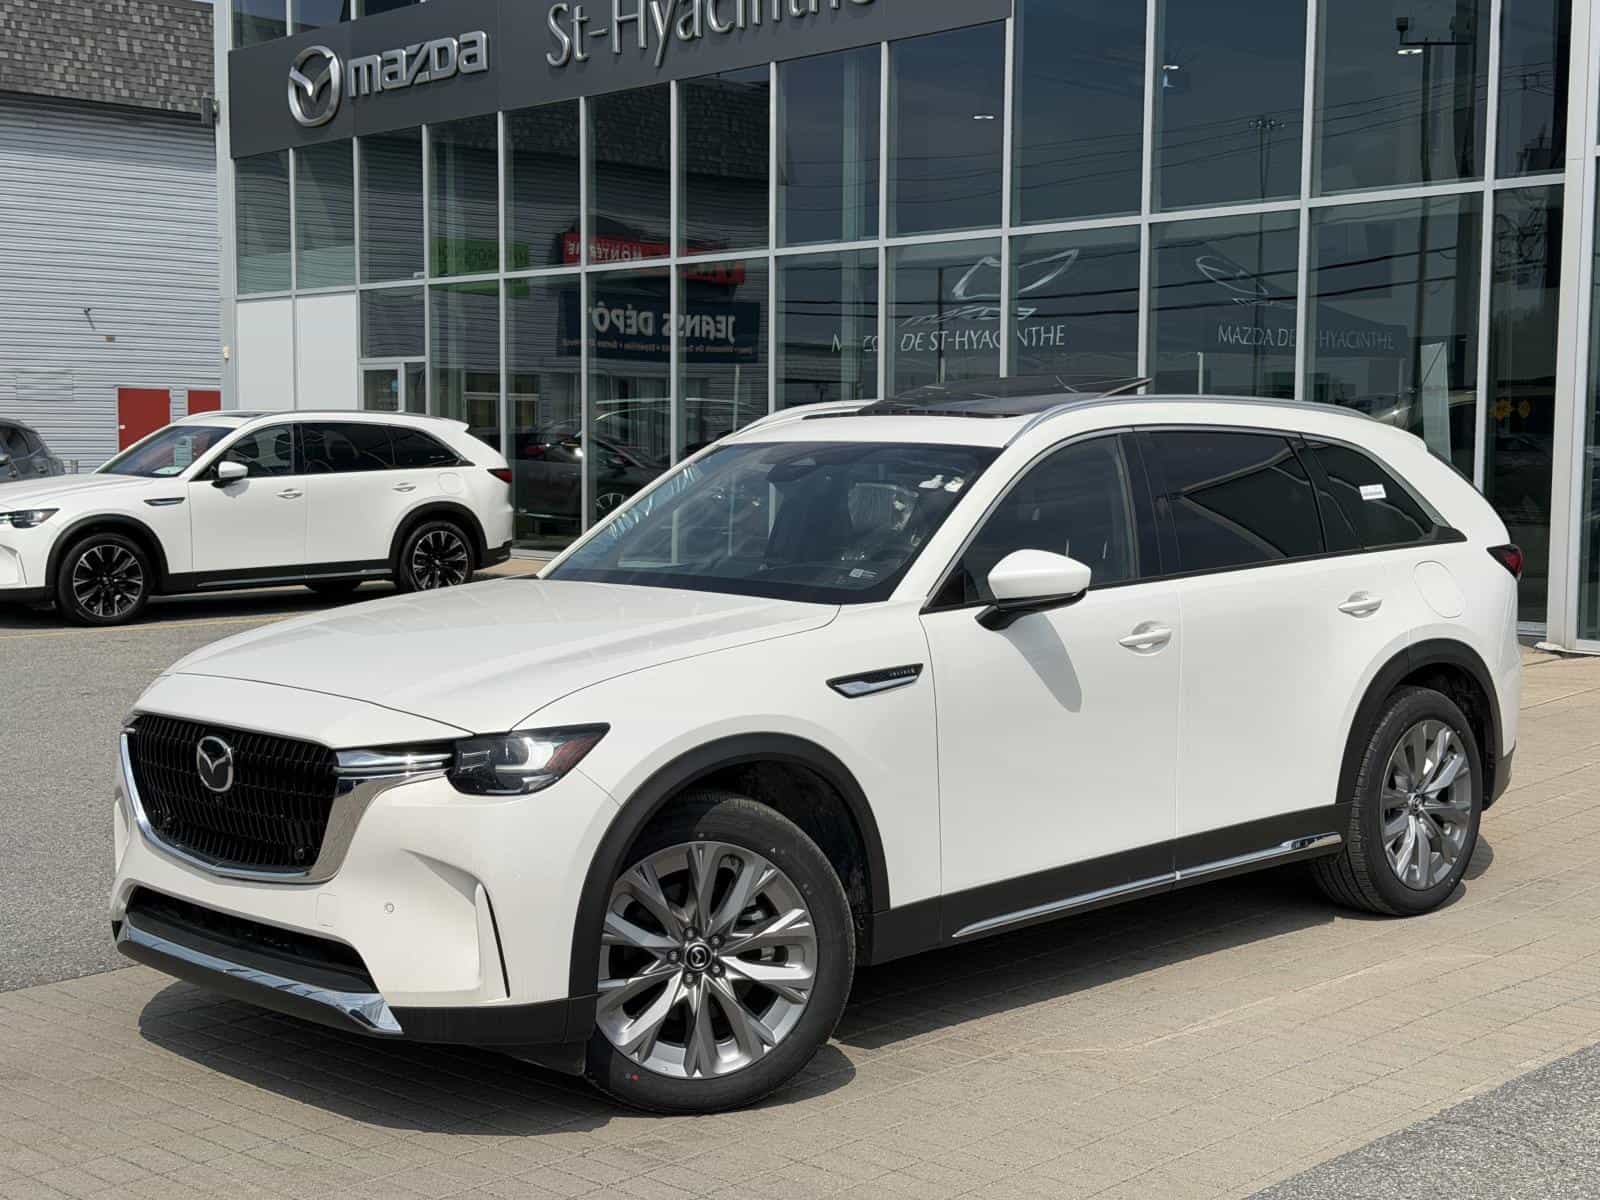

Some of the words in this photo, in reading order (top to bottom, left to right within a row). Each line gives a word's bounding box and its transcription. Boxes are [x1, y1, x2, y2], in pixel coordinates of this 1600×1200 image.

[546, 0, 877, 67] St-Hyac
[901, 333, 927, 351] DE
[929, 324, 1065, 351] ST-HYACNTHE
[1217, 324, 1274, 347] MAZDA
